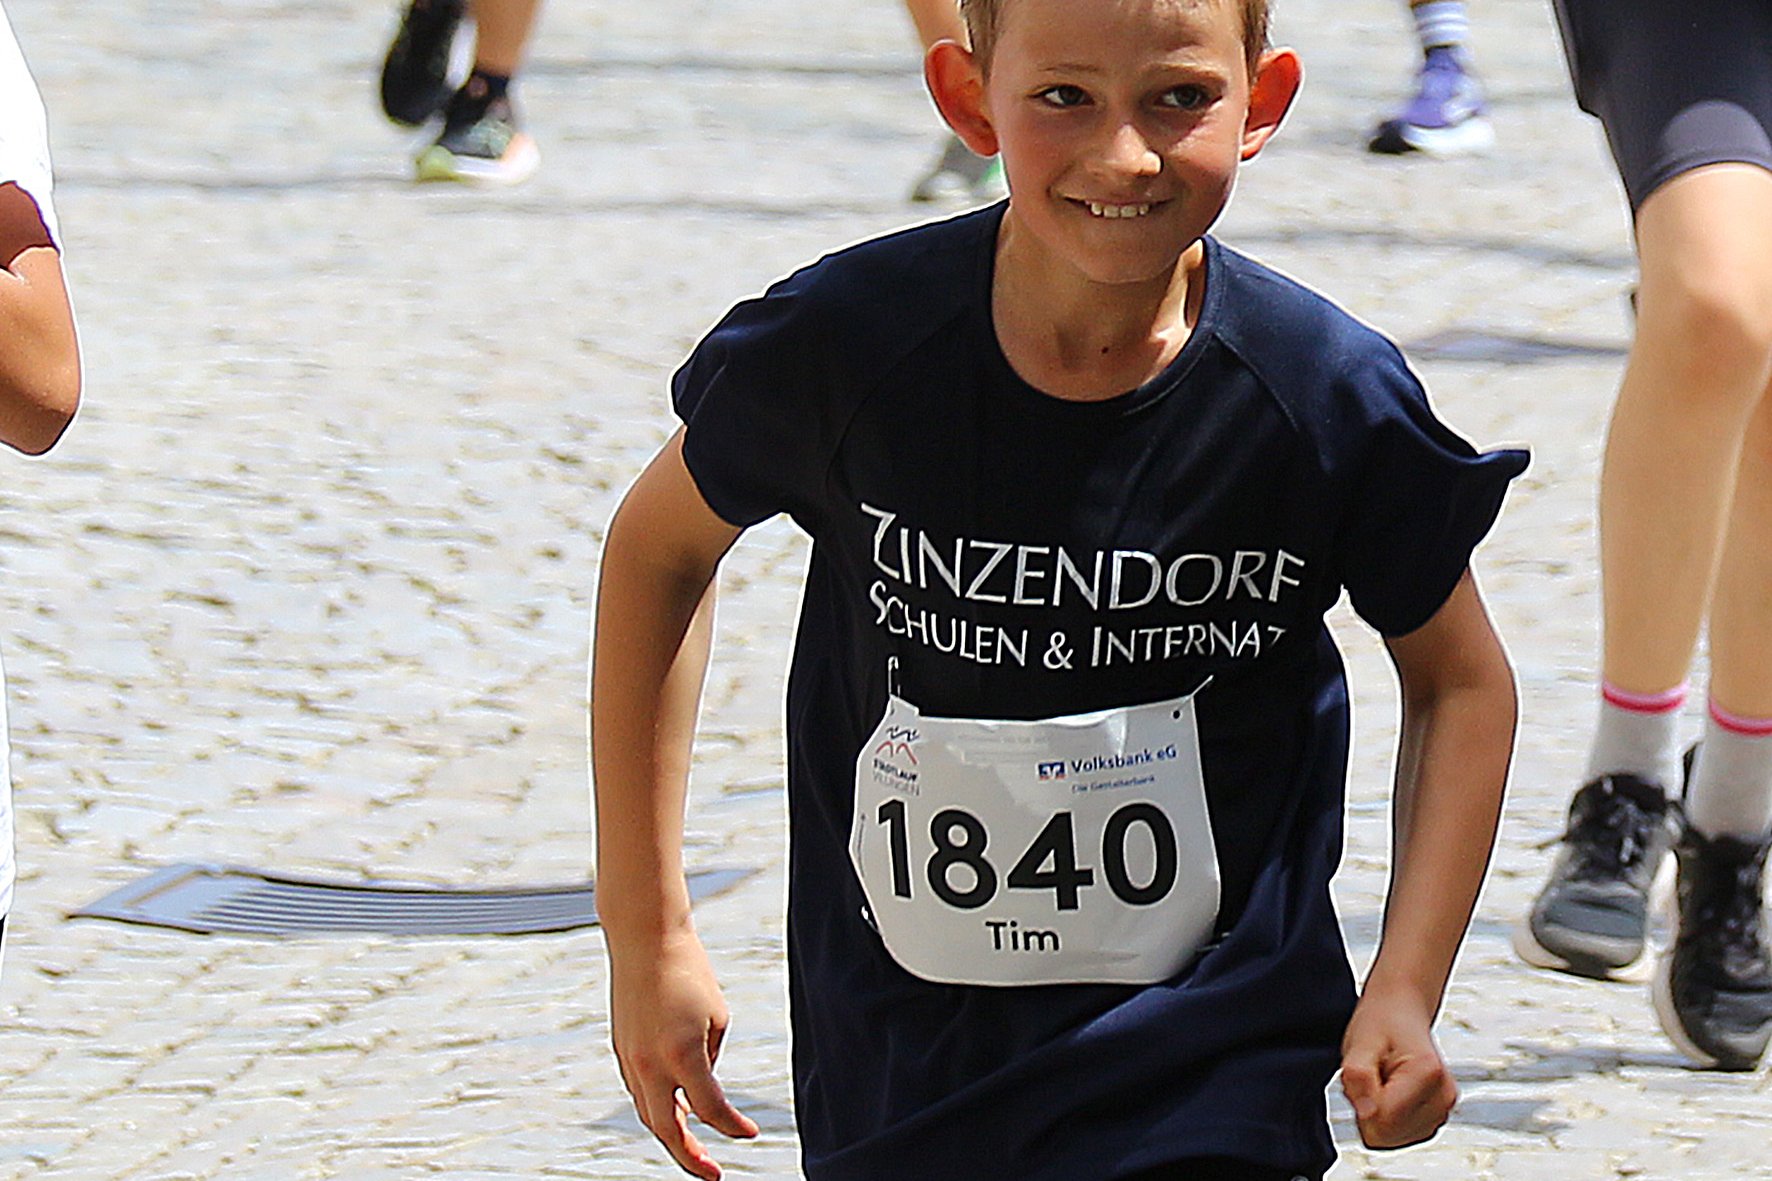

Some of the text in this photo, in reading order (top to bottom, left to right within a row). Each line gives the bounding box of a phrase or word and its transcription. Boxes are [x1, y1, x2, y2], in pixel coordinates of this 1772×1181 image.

[860, 502, 1306, 611] ZINZENDORF
[869, 579, 1287, 670] SCHULEN & INTERNAT
[1071, 743, 1177, 774] Volksbank eG
[877, 798, 1178, 911] 1840
[985, 920, 1060, 952] Tim
